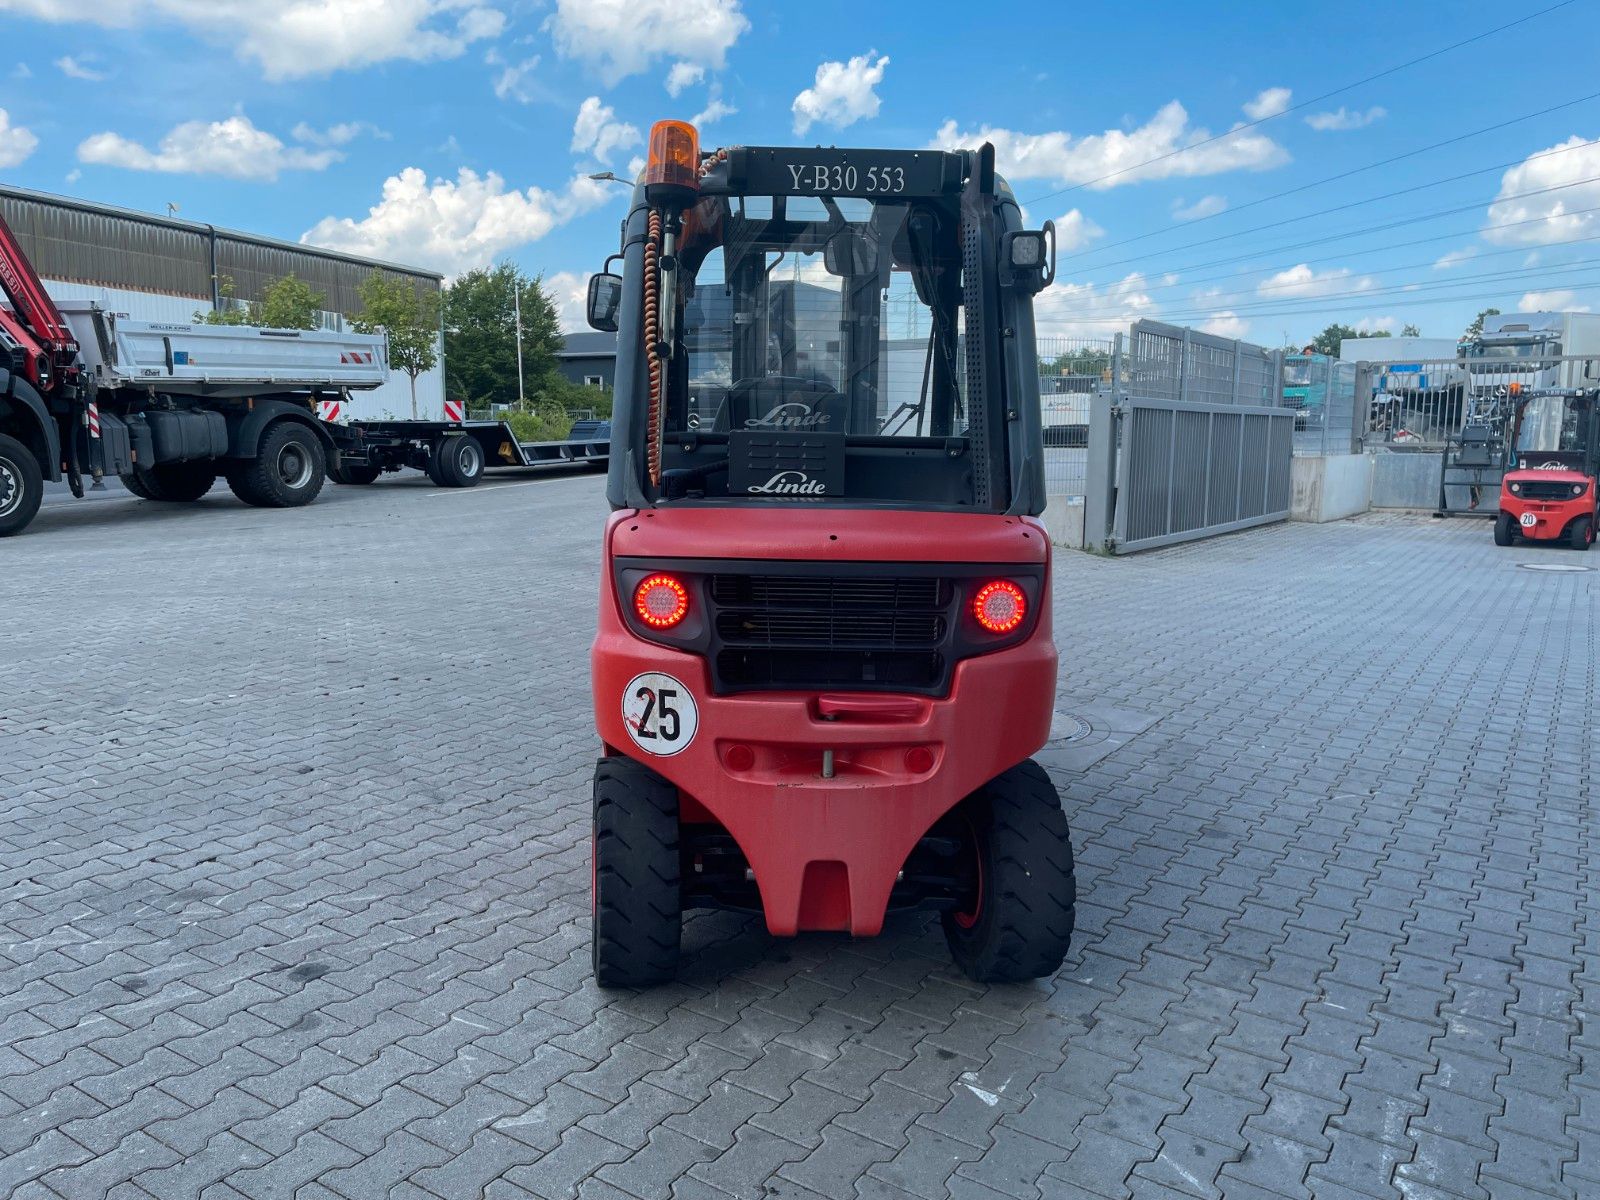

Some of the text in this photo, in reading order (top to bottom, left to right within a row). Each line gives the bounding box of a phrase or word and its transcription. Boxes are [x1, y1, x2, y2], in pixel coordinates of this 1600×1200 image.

[787, 164, 905, 192] Y-B30 553
[744, 402, 832, 427] Linde
[1533, 460, 1569, 471] Linde
[747, 470, 826, 494] Linde
[1522, 515, 1534, 525] 20
[636, 687, 680, 741] 25
